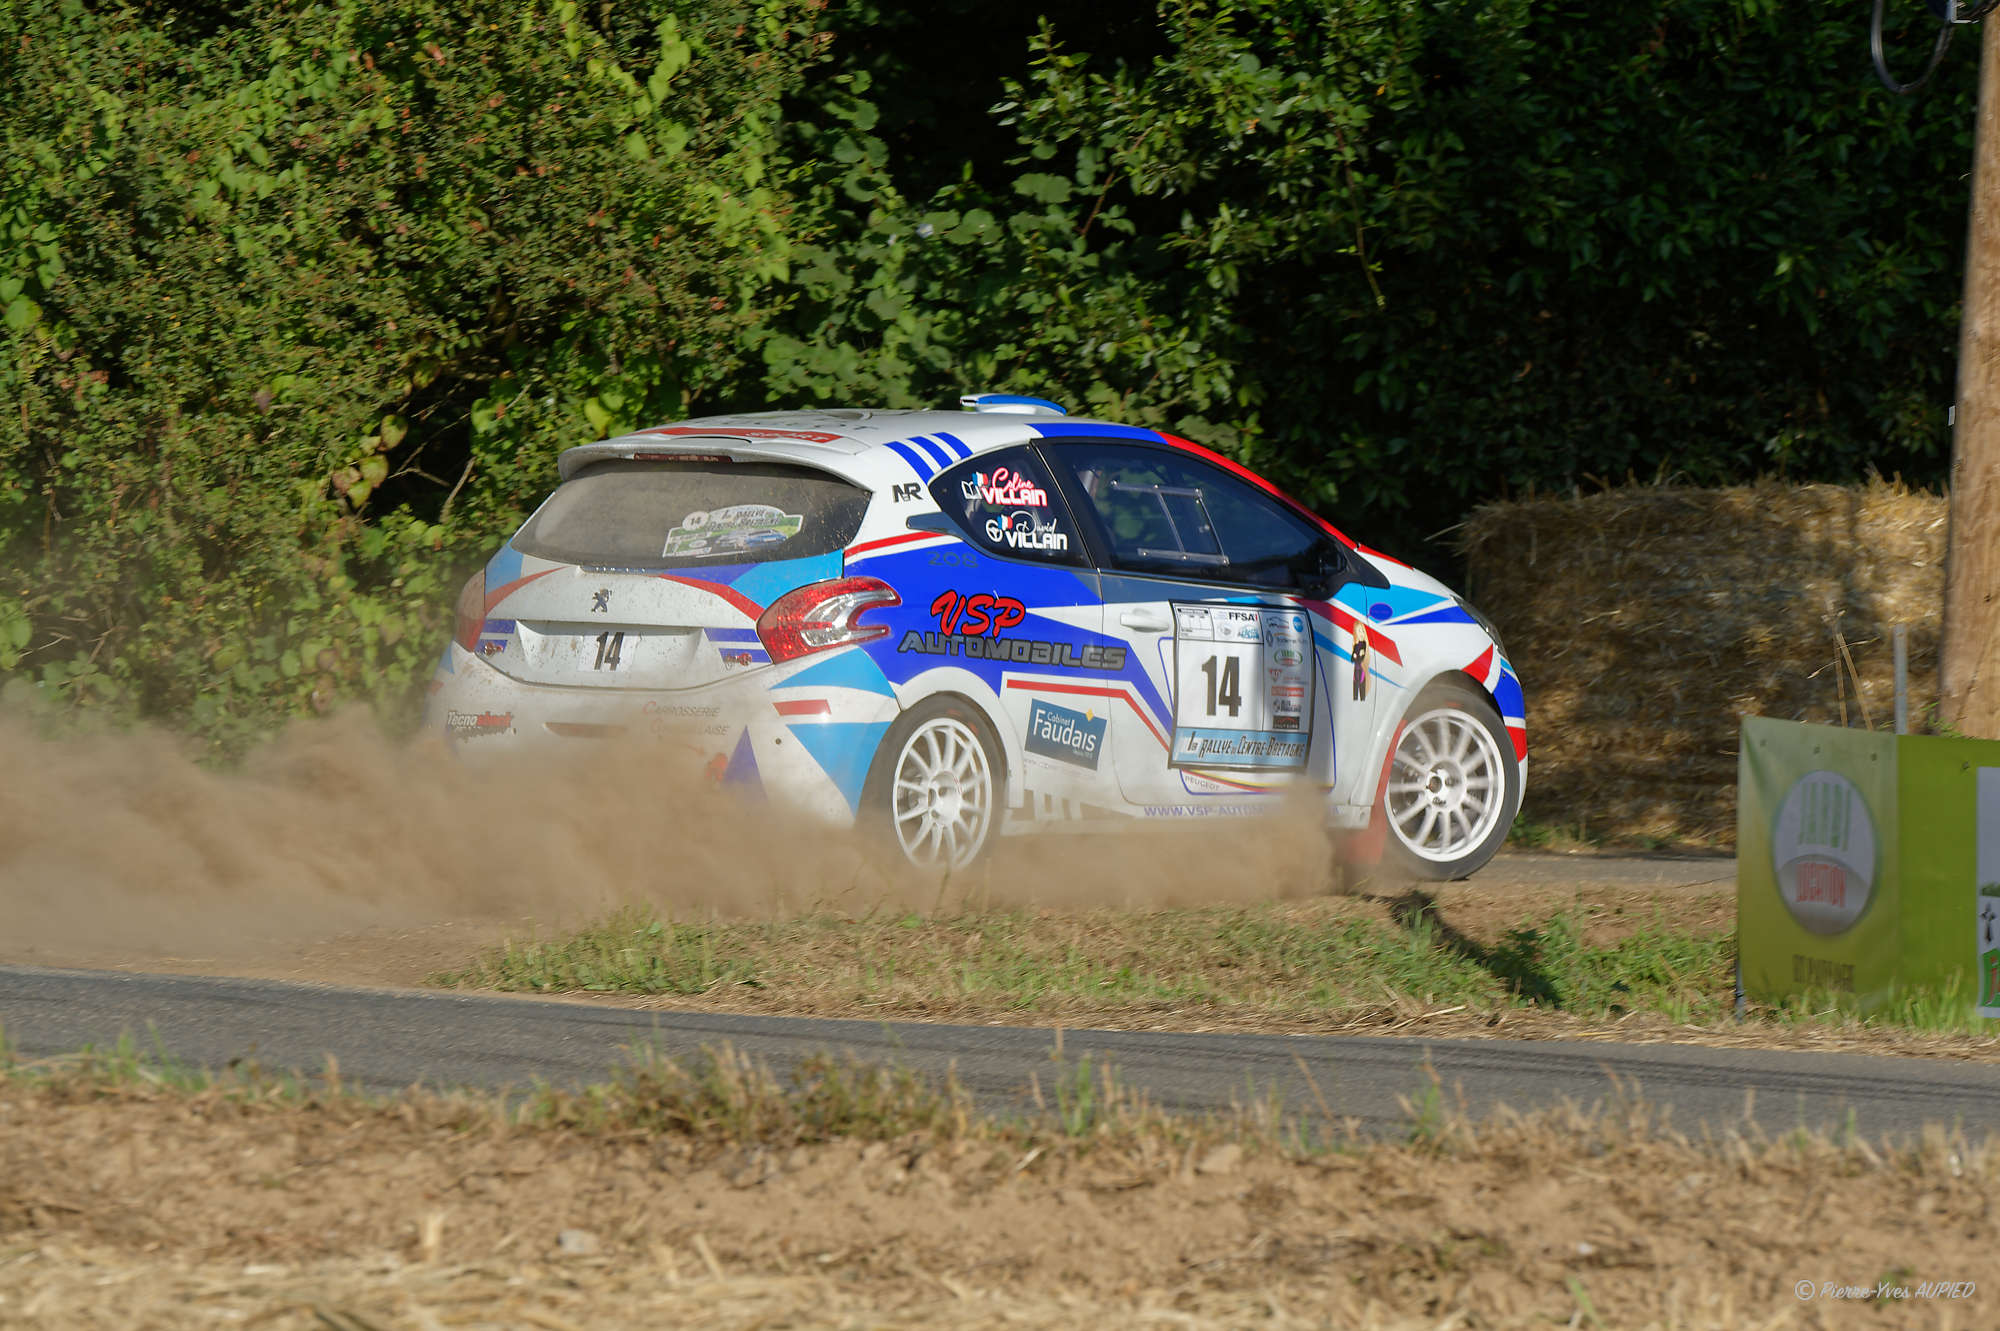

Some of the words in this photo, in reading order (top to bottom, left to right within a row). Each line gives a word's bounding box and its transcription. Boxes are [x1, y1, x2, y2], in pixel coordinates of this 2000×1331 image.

[992, 467, 1034, 490] Coline
[981, 487, 1048, 507] VILLAIN
[1011, 511, 1058, 534] David
[1006, 530, 1068, 551] VILLAIN
[927, 550, 979, 568] 208
[930, 588, 1026, 637] VSP
[1228, 611, 1256, 622] FFSA
[594, 632, 625, 671] 14
[897, 631, 1127, 670] AUTOMOBILES
[1201, 655, 1242, 717] 14
[1047, 711, 1071, 725] Cabinet
[1033, 708, 1097, 752] Faudais
[1198, 735, 1233, 759] RALLYE
[1184, 775, 1220, 791] PEUGEOT
